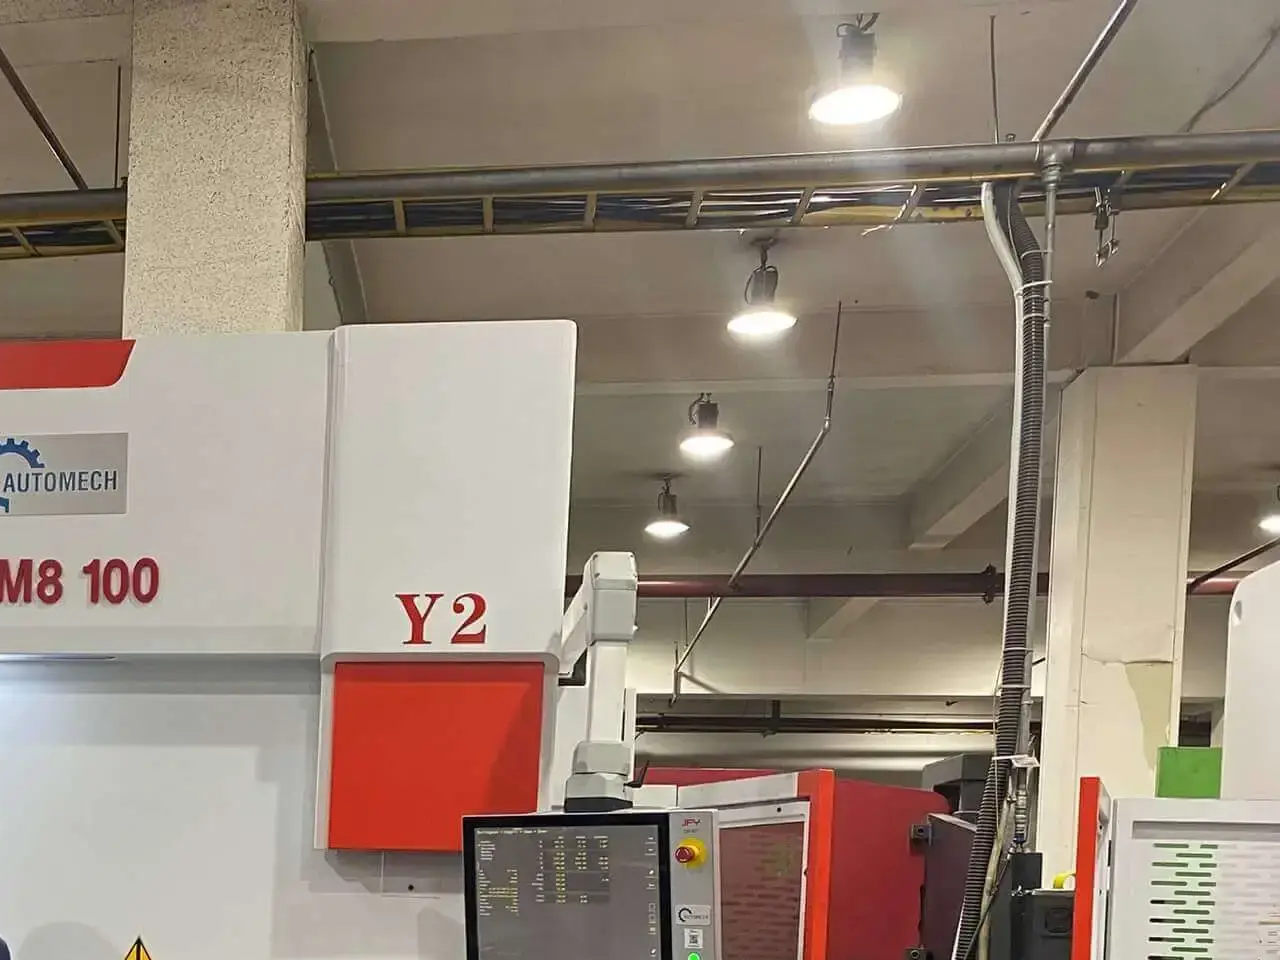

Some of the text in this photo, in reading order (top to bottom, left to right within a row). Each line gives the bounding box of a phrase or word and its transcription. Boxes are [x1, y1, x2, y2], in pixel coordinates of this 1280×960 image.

[3, 470, 117, 492] AUTOMECH
[83, 558, 159, 604] 100
[395, 593, 487, 644] Y2
